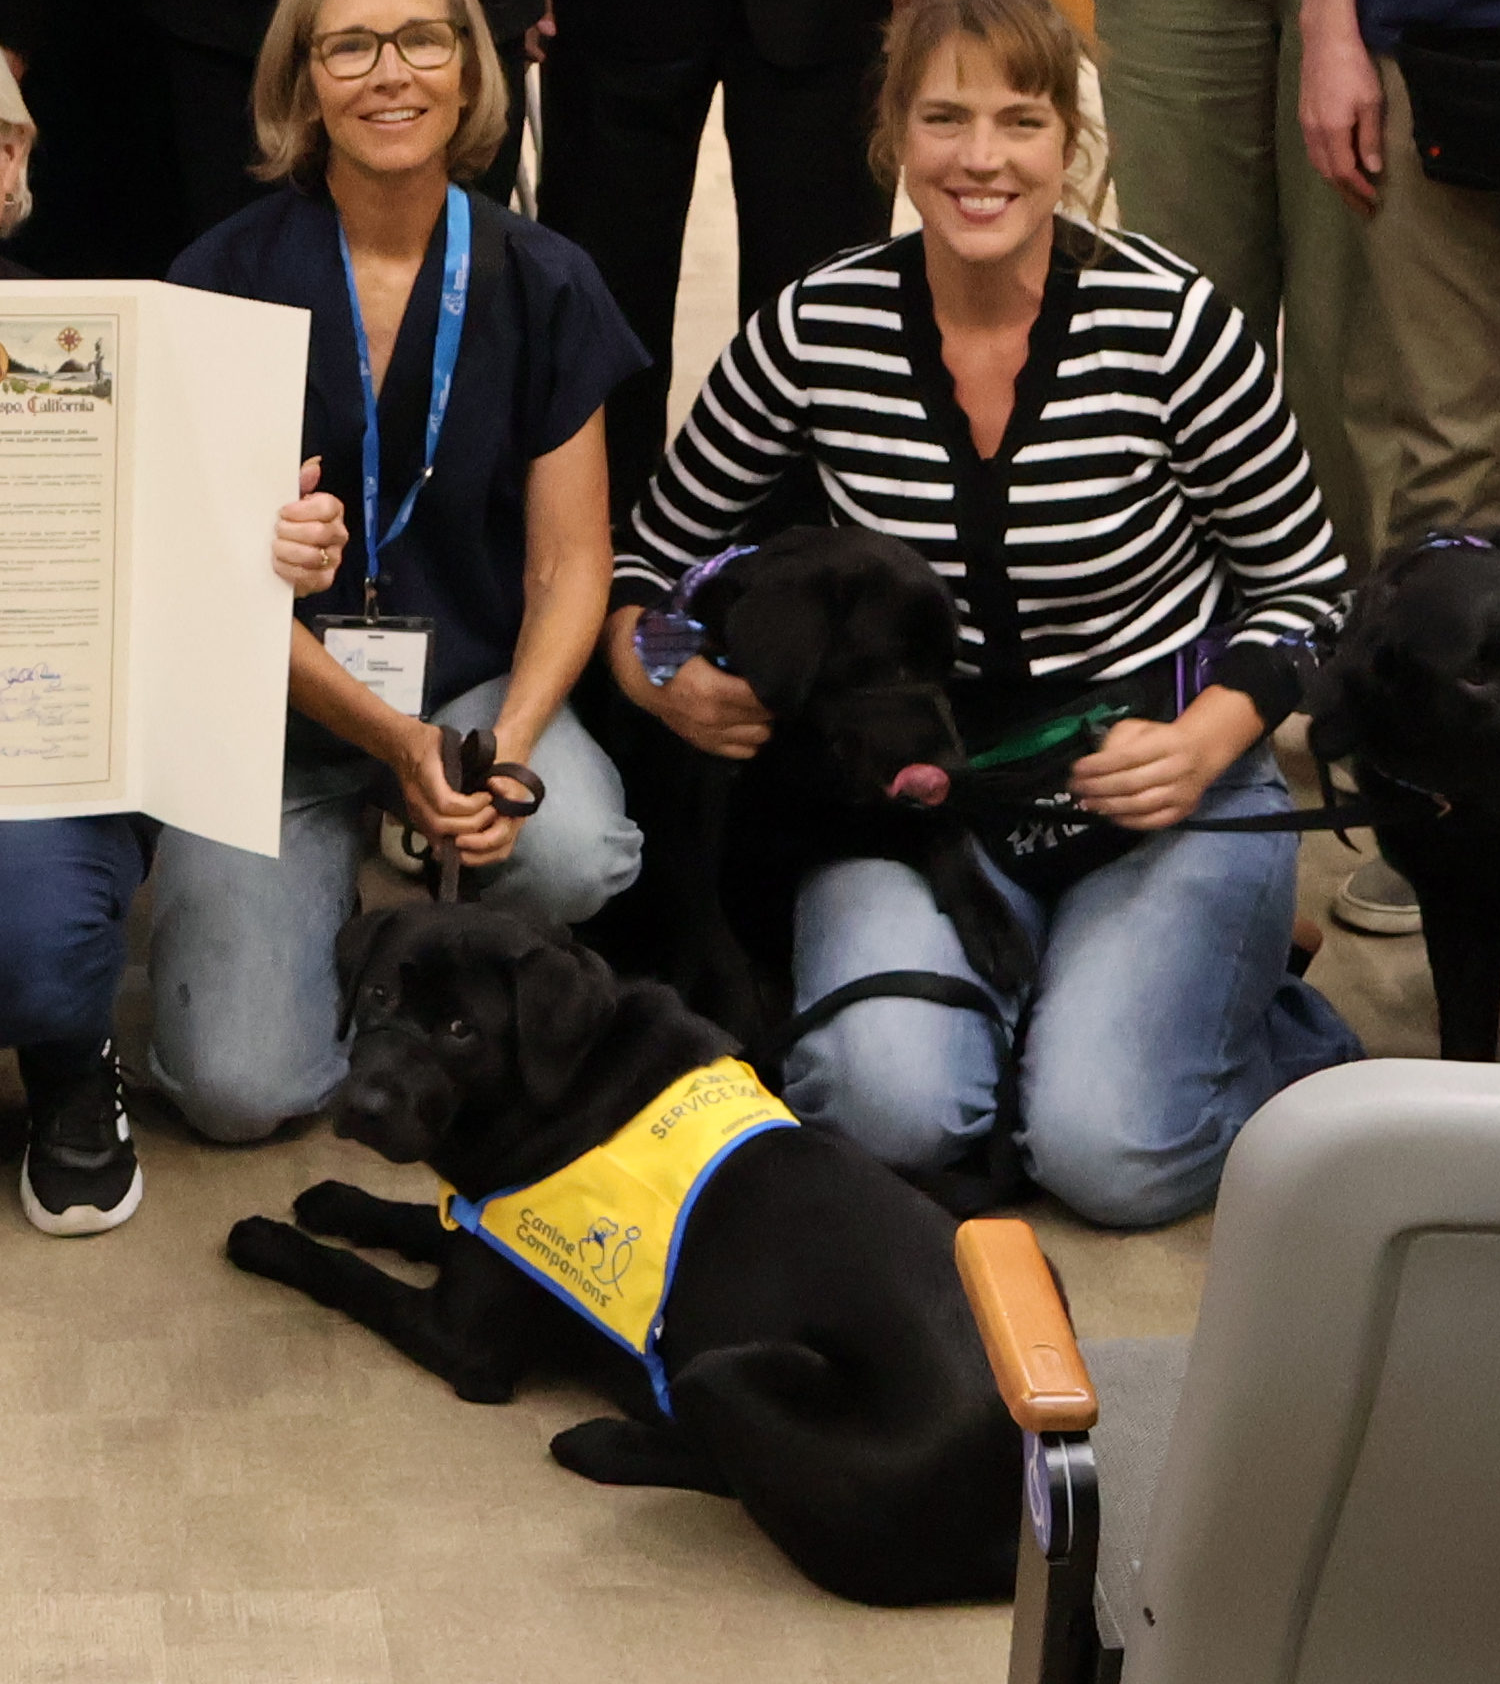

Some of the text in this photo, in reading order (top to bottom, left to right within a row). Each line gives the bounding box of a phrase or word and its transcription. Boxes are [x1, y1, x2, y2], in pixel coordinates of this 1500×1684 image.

[27, 395, 95, 417] California
[650, 1085, 733, 1140] SERVICE
[520, 1208, 576, 1257] Canine
[516, 1223, 612, 1308] Companions
